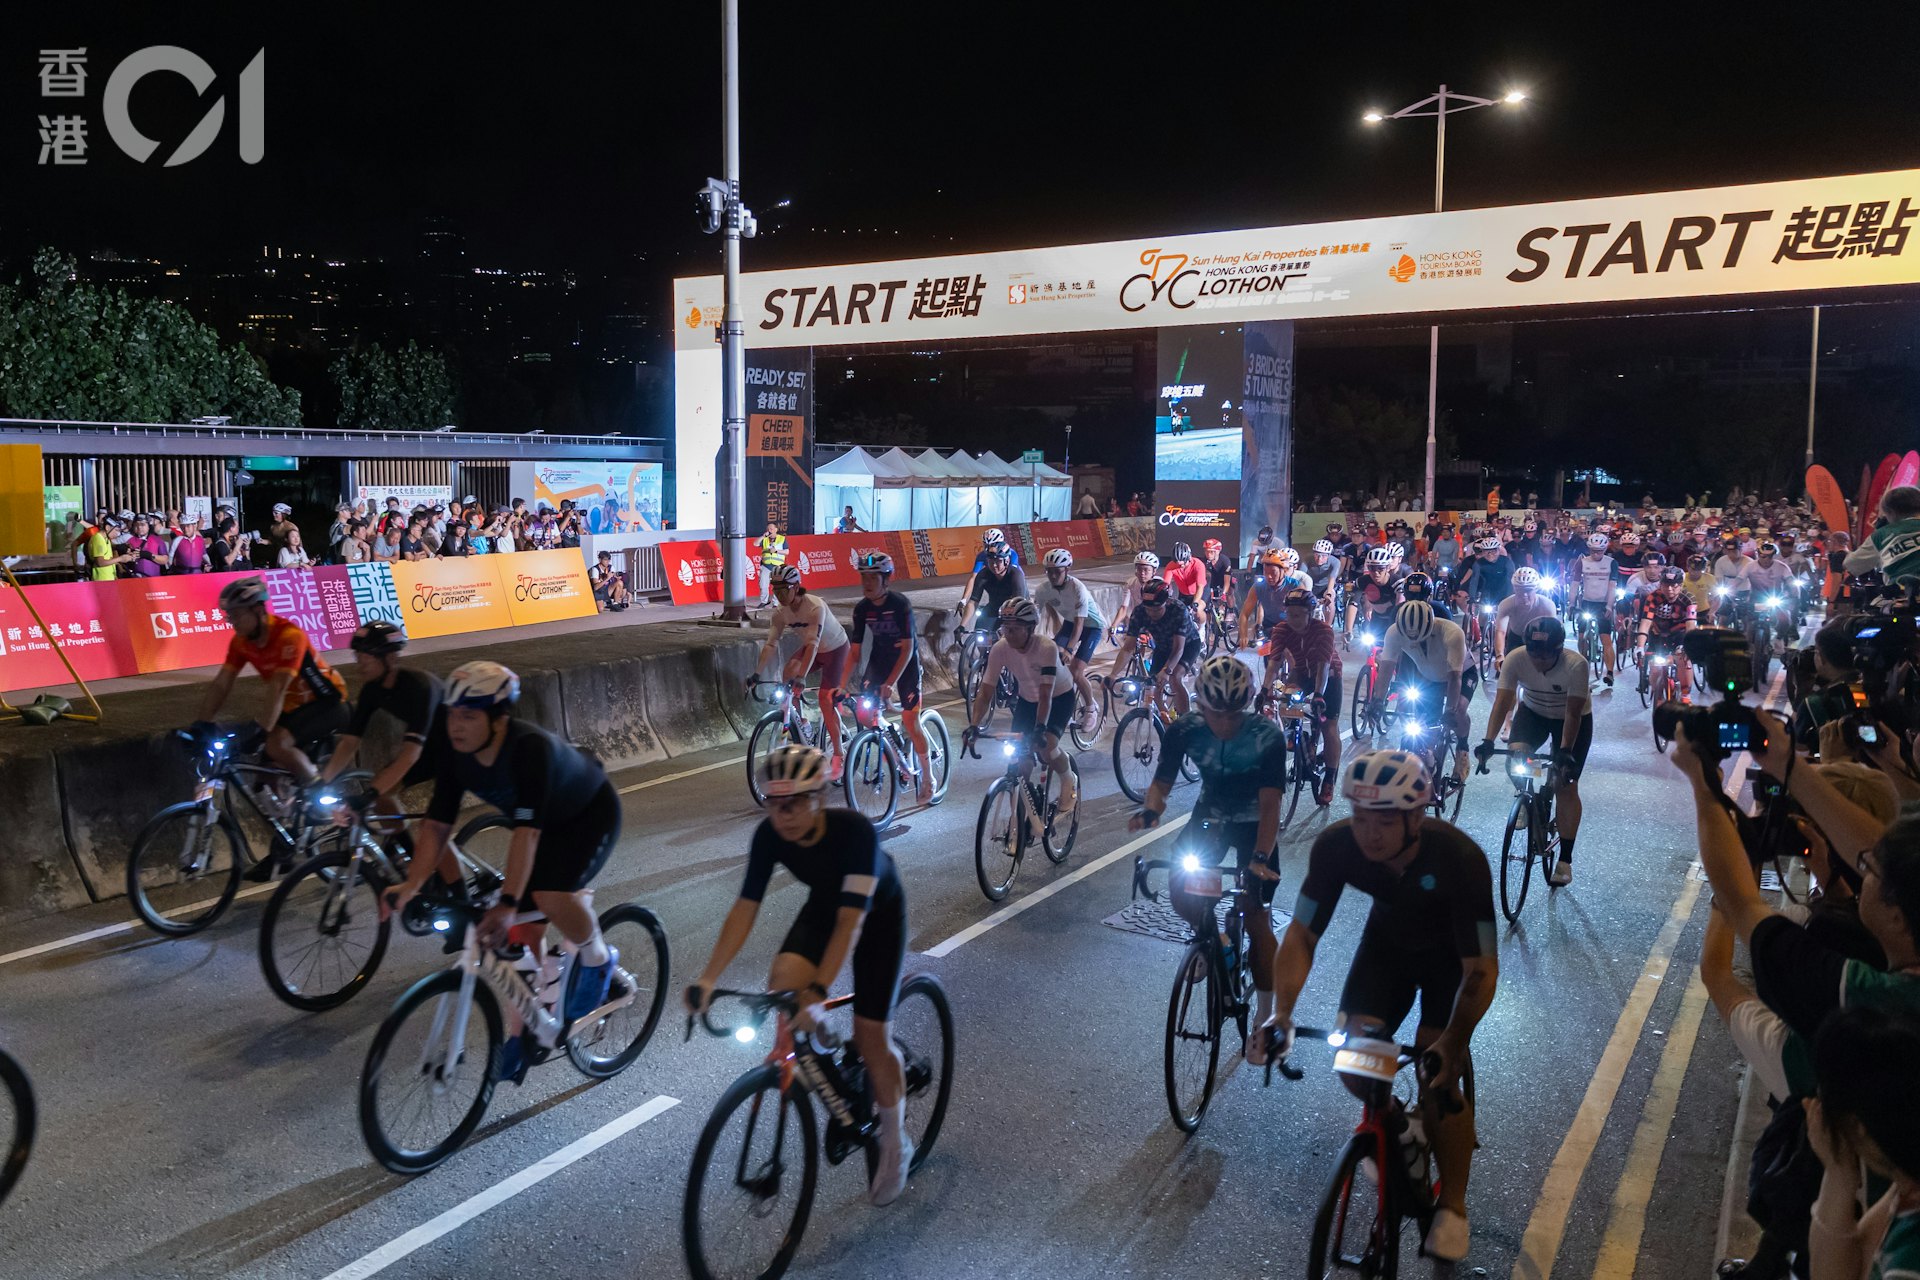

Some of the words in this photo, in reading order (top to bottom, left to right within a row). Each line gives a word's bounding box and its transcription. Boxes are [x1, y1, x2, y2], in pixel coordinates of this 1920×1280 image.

[1506, 209, 1774, 283] START
[1771, 197, 1920, 265] 起點
[1191, 256, 1210, 266] Sun
[1212, 254, 1240, 266] Hung
[1243, 250, 1260, 261] Kai
[1262, 246, 1317, 261] Properties
[1420, 252, 1450, 262] HONG
[1452, 249, 1482, 260] KONG
[1420, 262, 1453, 270] TOURISM
[1454, 259, 1482, 268] BOARD
[1205, 266, 1237, 277] HONG
[1238, 264, 1269, 275] KONG
[759, 279, 907, 330] START
[908, 274, 987, 321] 起點
[1248, 353, 1255, 374] 3
[1255, 354, 1291, 379] BRIDGES
[745, 367, 785, 388] READY,
[1244, 374, 1252, 395] 5
[1252, 375, 1290, 400] TUNNELS
[757, 391, 798, 410] 各就各位
[762, 419, 793, 433] CHEER
[321, 580, 346, 593] 只在
[325, 593, 353, 613] 香港
[328, 611, 354, 621] HONG
[331, 619, 357, 630] KONG
[180, 626, 194, 635] Sun
[194, 625, 213, 634] Hung
[213, 623, 225, 631] Kai
[10, 644, 27, 653] Sun
[28, 641, 51, 650] Hung
[66, 635, 106, 647] Properties
